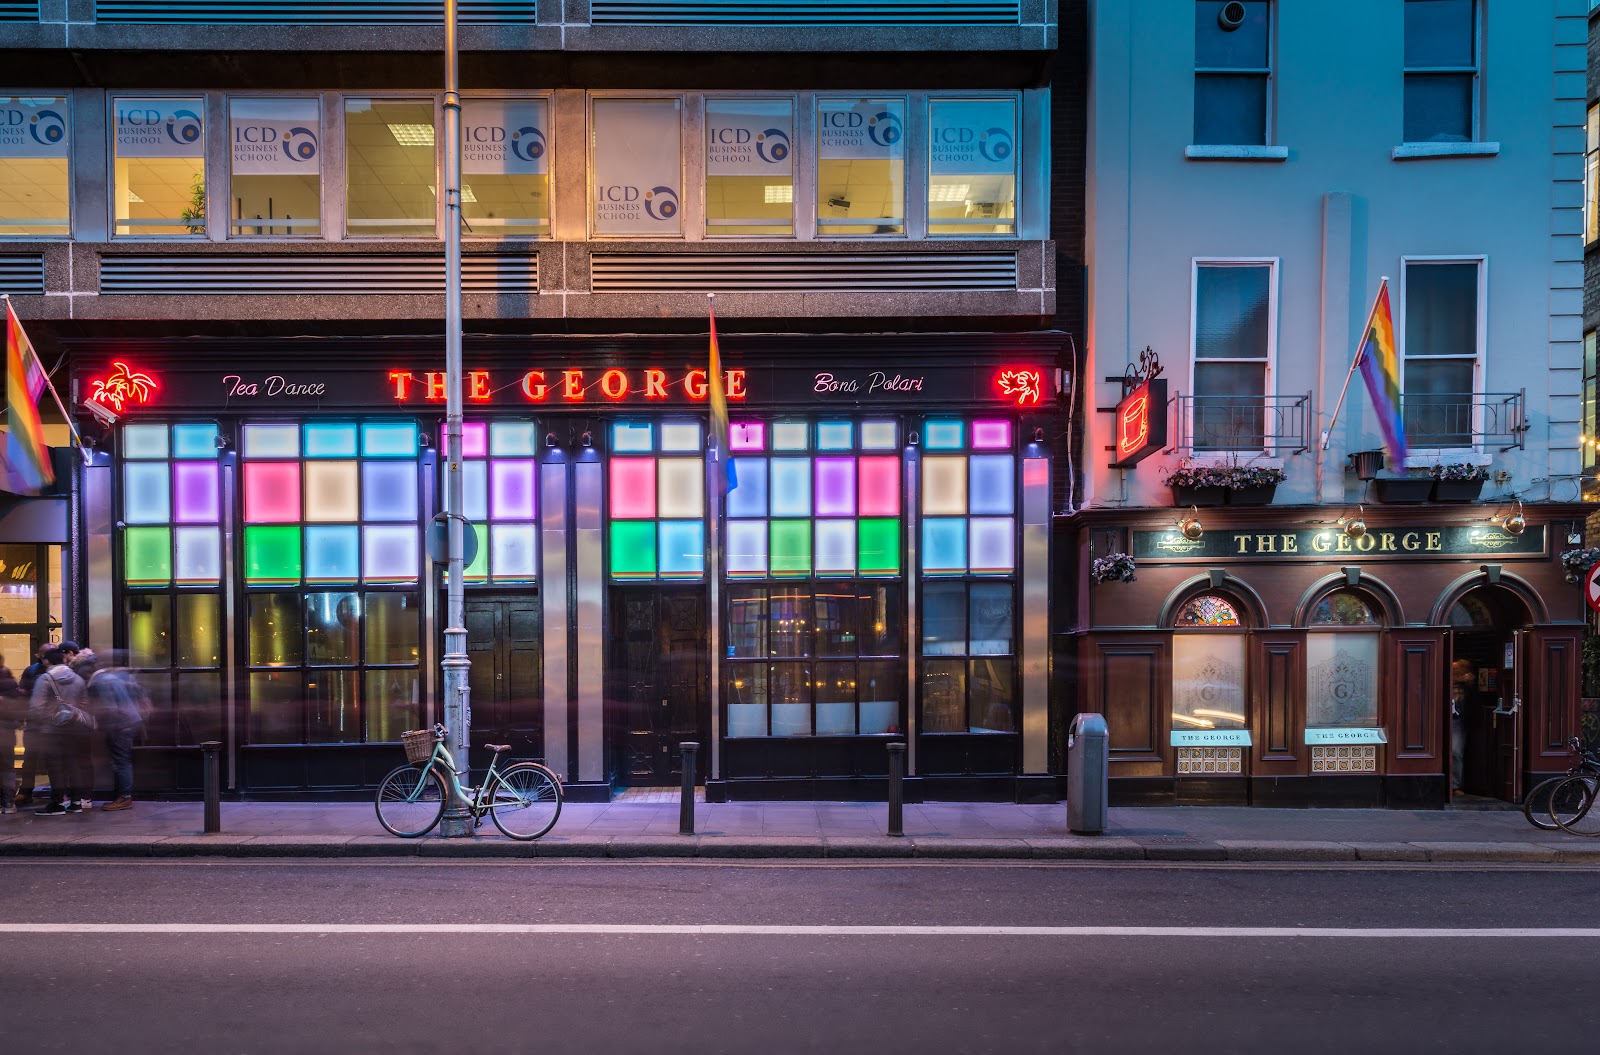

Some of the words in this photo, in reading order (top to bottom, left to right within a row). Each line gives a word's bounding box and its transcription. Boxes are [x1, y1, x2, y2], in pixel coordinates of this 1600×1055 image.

[0, 110, 24, 126] D
[119, 110, 161, 126] ICD
[823, 112, 863, 128] ICD
[118, 128, 162, 136] BUSINESS
[235, 127, 277, 142] ICD
[465, 127, 506, 142] ICD
[710, 128, 751, 144] ICD
[934, 127, 974, 143] ICD
[118, 136, 162, 144] SCHOOL
[821, 138, 864, 146] SCHOOL
[234, 144, 278, 152] BUSINESS
[464, 144, 508, 152] BUSINESS
[234, 154, 278, 162] SCHOOL
[464, 153, 508, 161] SCHOOL
[709, 155, 752, 163] SCHOOL
[932, 153, 975, 162] SCHOOL
[599, 186, 640, 201] ICD
[597, 203, 640, 211] BUSINESS
[597, 212, 641, 220] SCHOOL
[222, 375, 258, 396] Tea
[264, 375, 325, 396] Dance
[389, 371, 491, 399] THE
[521, 370, 747, 399] GEORGE
[868, 371, 924, 394] Polari
[1233, 533, 1298, 553] THE
[1311, 532, 1442, 552] GEORGE
[1200, 686, 1215, 701] G
[1334, 684, 1348, 698] G
